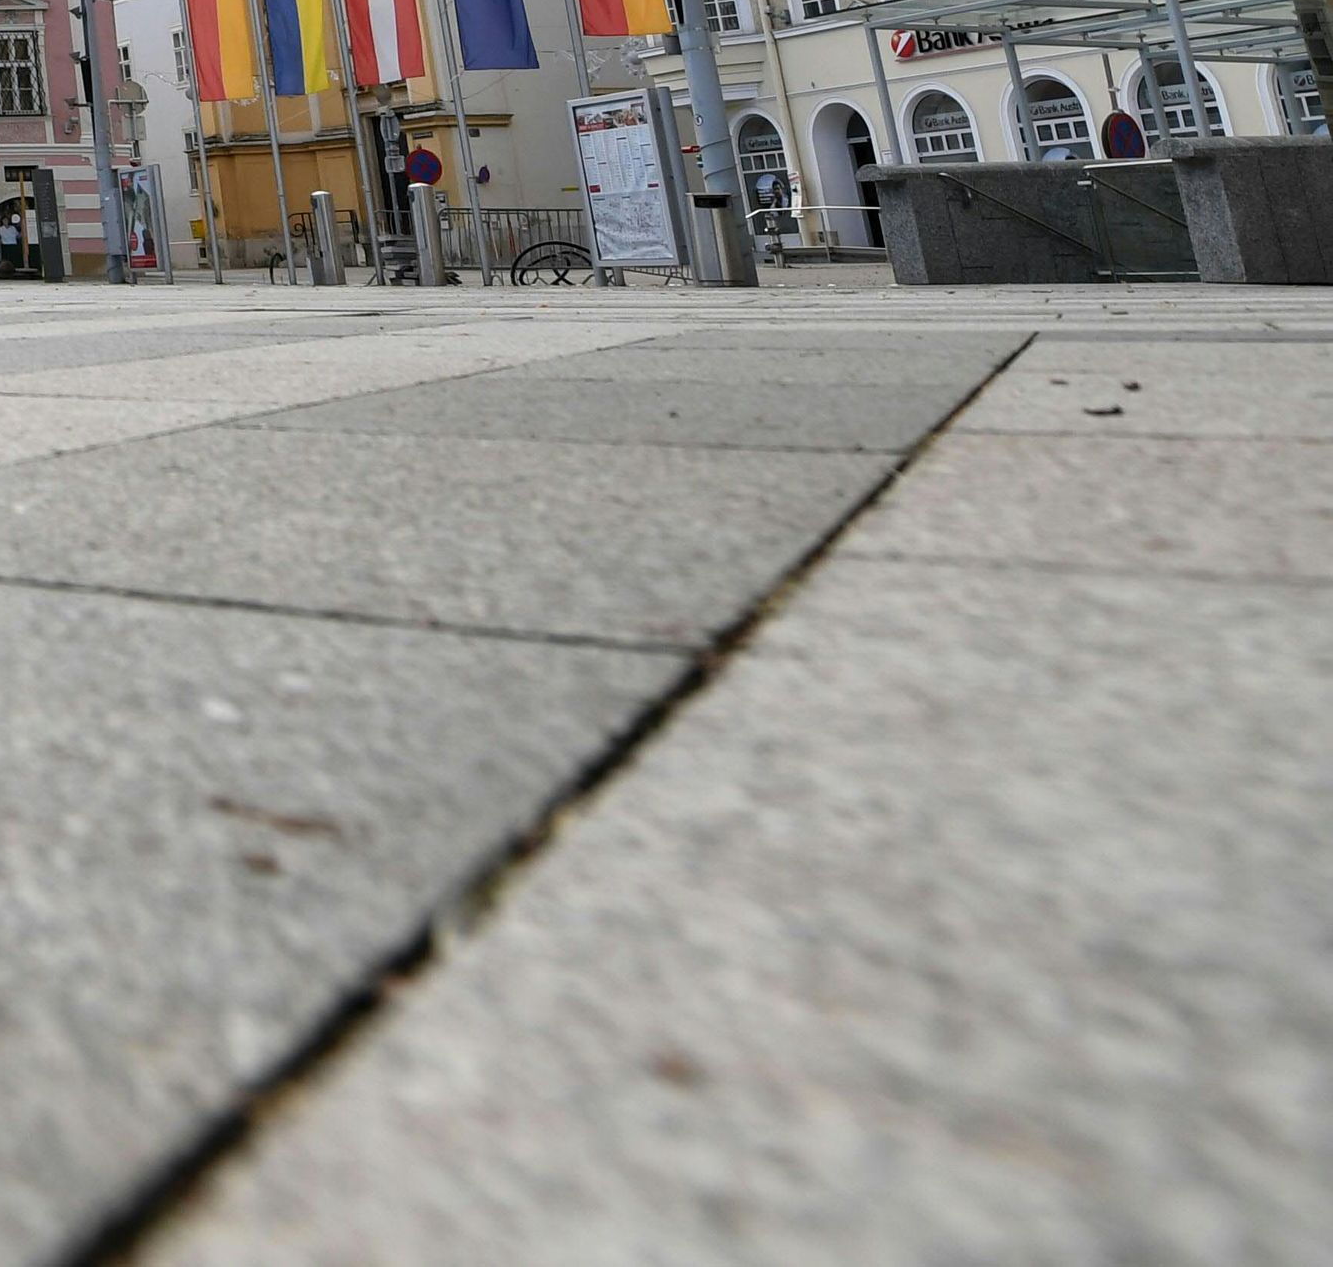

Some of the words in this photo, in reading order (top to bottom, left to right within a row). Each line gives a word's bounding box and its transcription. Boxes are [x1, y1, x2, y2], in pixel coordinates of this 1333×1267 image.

[915, 29, 973, 53] Bank
[1161, 89, 1186, 101] Bank
[1039, 104, 1059, 115] Bank
